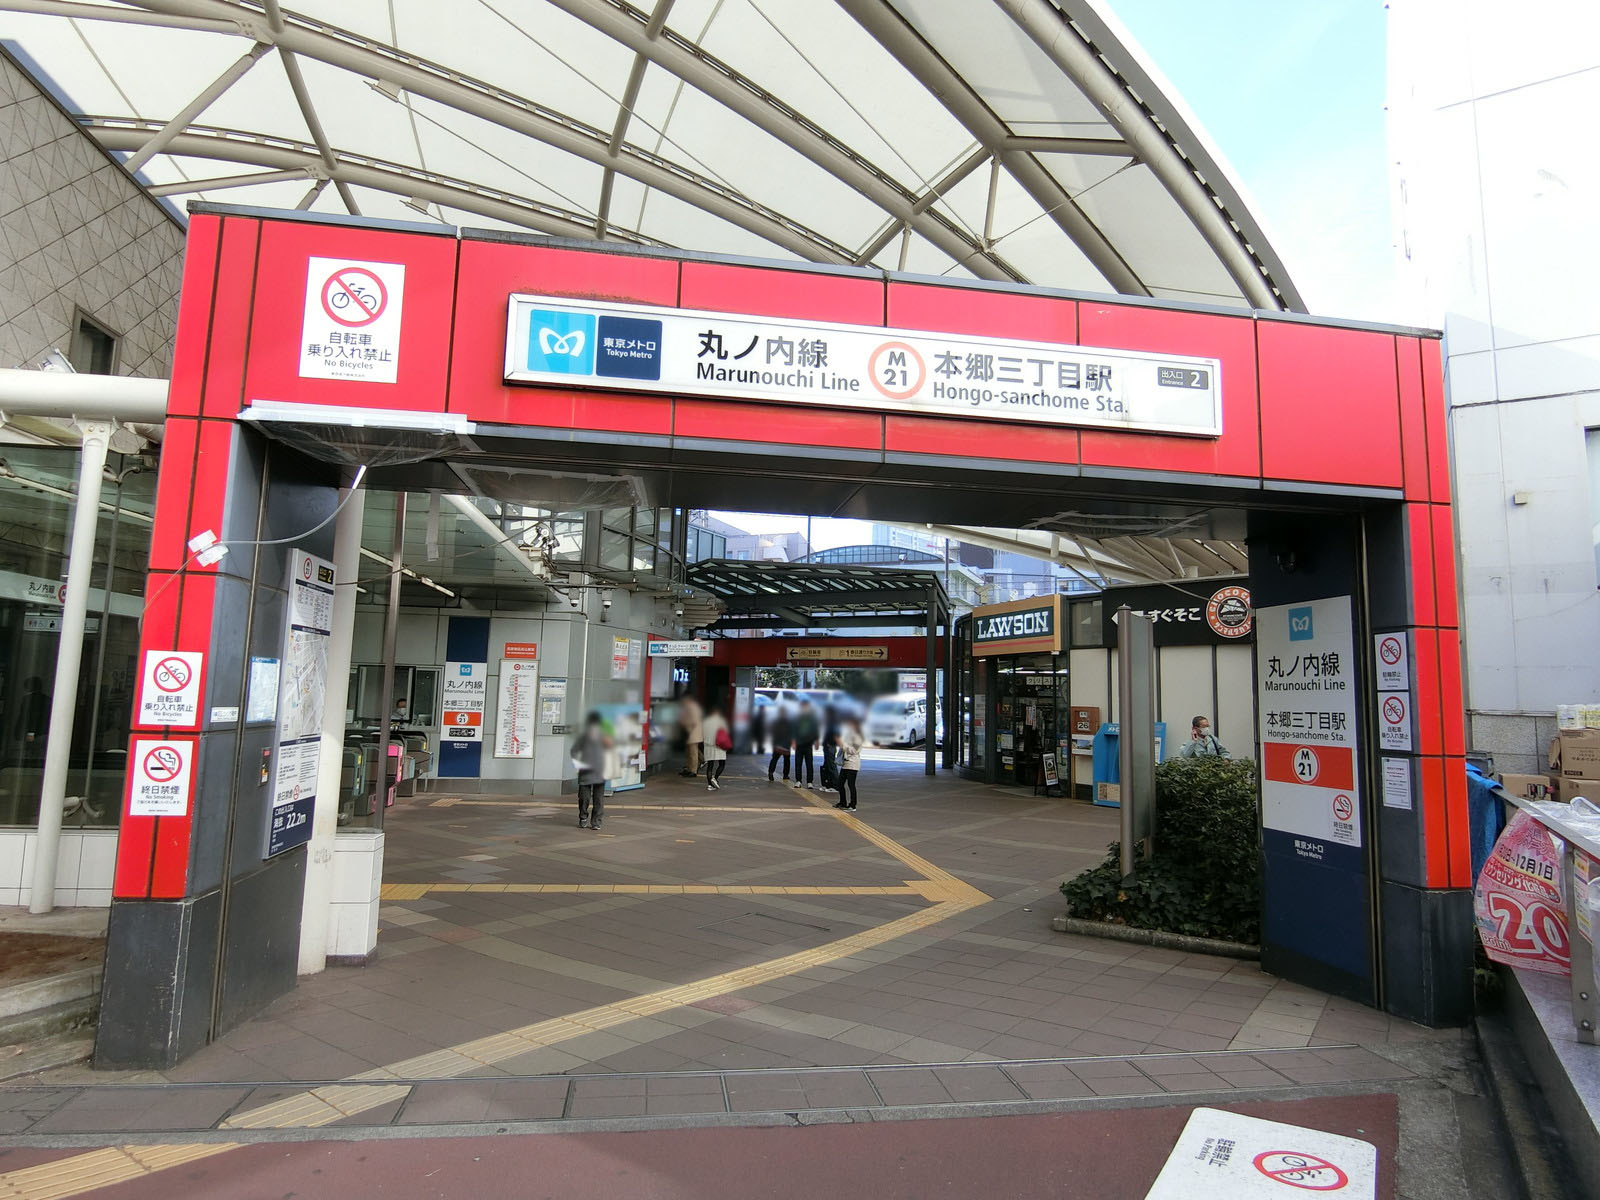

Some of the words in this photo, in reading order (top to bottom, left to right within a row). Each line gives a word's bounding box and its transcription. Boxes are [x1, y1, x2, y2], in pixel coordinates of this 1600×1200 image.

[329, 331, 372, 345] 自転車
[603, 337, 656, 351] 東京メトロ
[307, 343, 392, 362] 乗り入れ禁止
[606, 348, 628, 358] Tokyo
[630, 350, 652, 359] Metro
[697, 329, 828, 368] 丸ノ内線
[324, 359, 336, 367] No
[339, 360, 373, 370] Bicycles
[888, 351, 906, 367] M
[697, 362, 814, 389] Marunouchi
[821, 373, 860, 392] Line
[883, 369, 908, 387] 21
[934, 350, 1112, 392] 本郷三丁目駅
[1161, 370, 1183, 379] 出入口
[1190, 371, 1201, 387] 2
[933, 381, 1090, 411] Hongo-sanchome
[1096, 396, 1129, 414] Sta.
[29, 581, 55, 594] 丸ノ内線
[1147, 607, 1201, 623] すぐそこ
[977, 611, 1049, 639] LAWSON
[1268, 652, 1340, 678] 丸ノ内線
[447, 680, 483, 689] 丸ノ内線
[1265, 679, 1320, 691] Marunouchi
[1324, 679, 1345, 691] Line
[157, 694, 182, 703] 自転車
[145, 703, 193, 712] 乗り入れ禁止
[1266, 710, 1346, 730] 本郷三丁目駅
[1267, 729, 1329, 741] Hongo-sanchome
[1331, 732, 1346, 741] Sta.
[1301, 751, 1310, 760] M
[1298, 763, 1312, 776] 21
[141, 785, 180, 794] 終日禁煙
[286, 812, 306, 829] 22.2m
[1294, 840, 1323, 853] 東京メトロ
[1296, 849, 1308, 857] Tokyo
[1309, 852, 1322, 860] Metro
